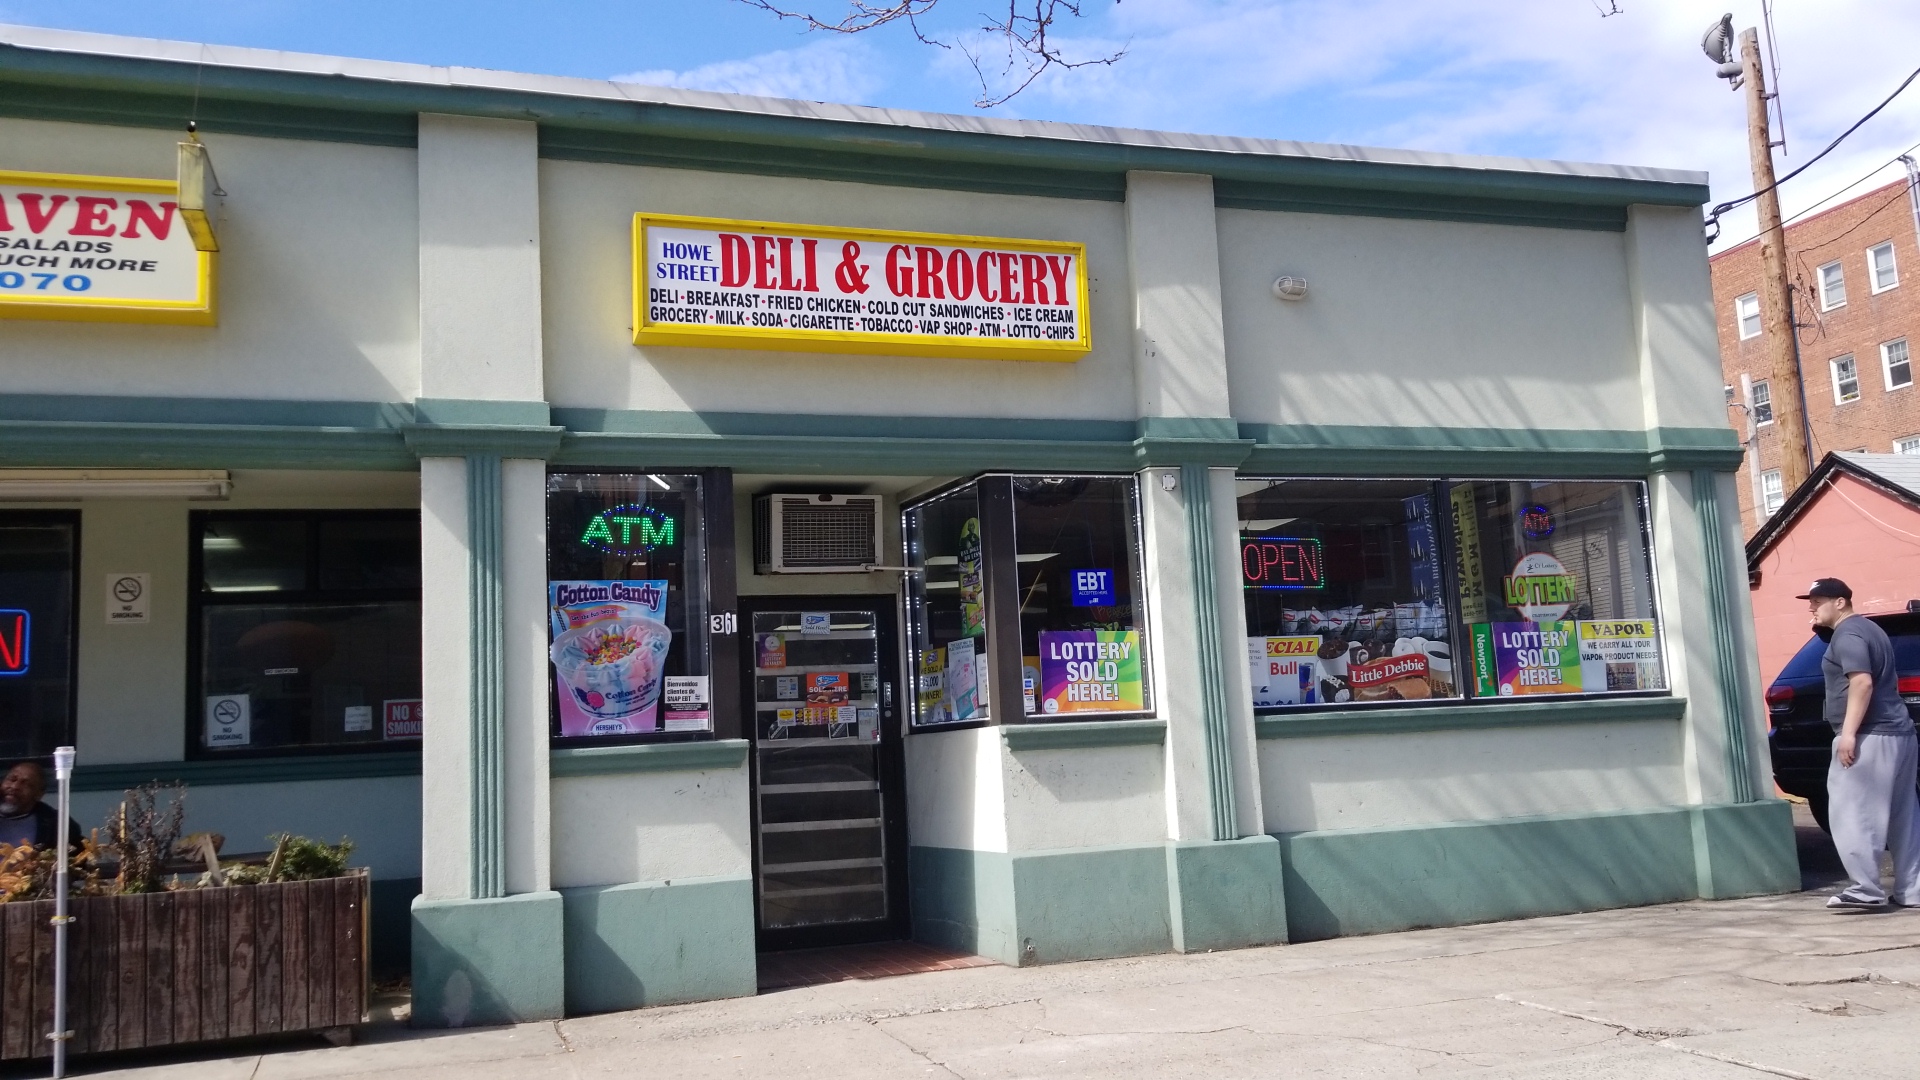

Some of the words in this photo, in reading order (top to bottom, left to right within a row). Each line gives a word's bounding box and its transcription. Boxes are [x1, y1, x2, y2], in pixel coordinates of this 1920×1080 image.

[0, 193, 179, 240] VEN
[663, 242, 713, 261] HOWE
[70, 257, 158, 272] MORE
[656, 263, 719, 282] STREET
[718, 234, 819, 292] DELI
[835, 240, 870, 294] &
[885, 244, 1072, 305] GROCERY
[650, 288, 678, 304] DELI
[686, 291, 760, 308] BREAKFAST
[768, 295, 803, 311] FRIED
[807, 297, 861, 313] CHICKEN
[868, 301, 899, 316] COLD
[902, 303, 926, 317] CUT
[929, 304, 1004, 320] SANDWICHES
[1014, 308, 1032, 322] ICE
[1035, 308, 1073, 323] CREAM
[650, 306, 708, 323] GROCERY
[716, 310, 745, 325] MILK
[752, 312, 783, 328] SODA
[790, 314, 854, 330] CIGARETTE
[861, 317, 913, 333] TOBACCO
[919, 320, 940, 334] VAP
[944, 321, 972, 336] SHOP
[979, 323, 1001, 337] ATM
[1007, 324, 1041, 339] LOTTO
[1046, 325, 1074, 339] CHIPS
[581, 516, 674, 545] ATM
[1524, 513, 1549, 529] ATM
[1243, 544, 1318, 581] OPEN
[1077, 572, 1106, 590] EBT
[1505, 575, 1577, 605] LOTTERY
[557, 583, 609, 607] Cotton
[610, 581, 662, 611] Candy
[1502, 630, 1568, 648] LOTTERY
[1591, 624, 1646, 636] VAPOR
[1050, 642, 1132, 660] LOTTERY
[1267, 641, 1315, 653] ECIAL
[1599, 641, 1620, 649] CARRY
[1634, 640, 1651, 648] YOUR
[1476, 633, 1488, 679] Newport
[1516, 648, 1560, 668] SOLD
[1581, 653, 1603, 661] VAPOR
[1604, 652, 1634, 661] PRODUCT
[1066, 661, 1118, 682] SOLD
[1270, 661, 1297, 675] Bull
[1352, 668, 1382, 683] Little
[1384, 657, 1425, 677] Debbie
[1519, 669, 1562, 686] HERE!
[1067, 683, 1119, 702] HERE!
[392, 705, 409, 720] NO
[387, 721, 423, 734] SMOKI
